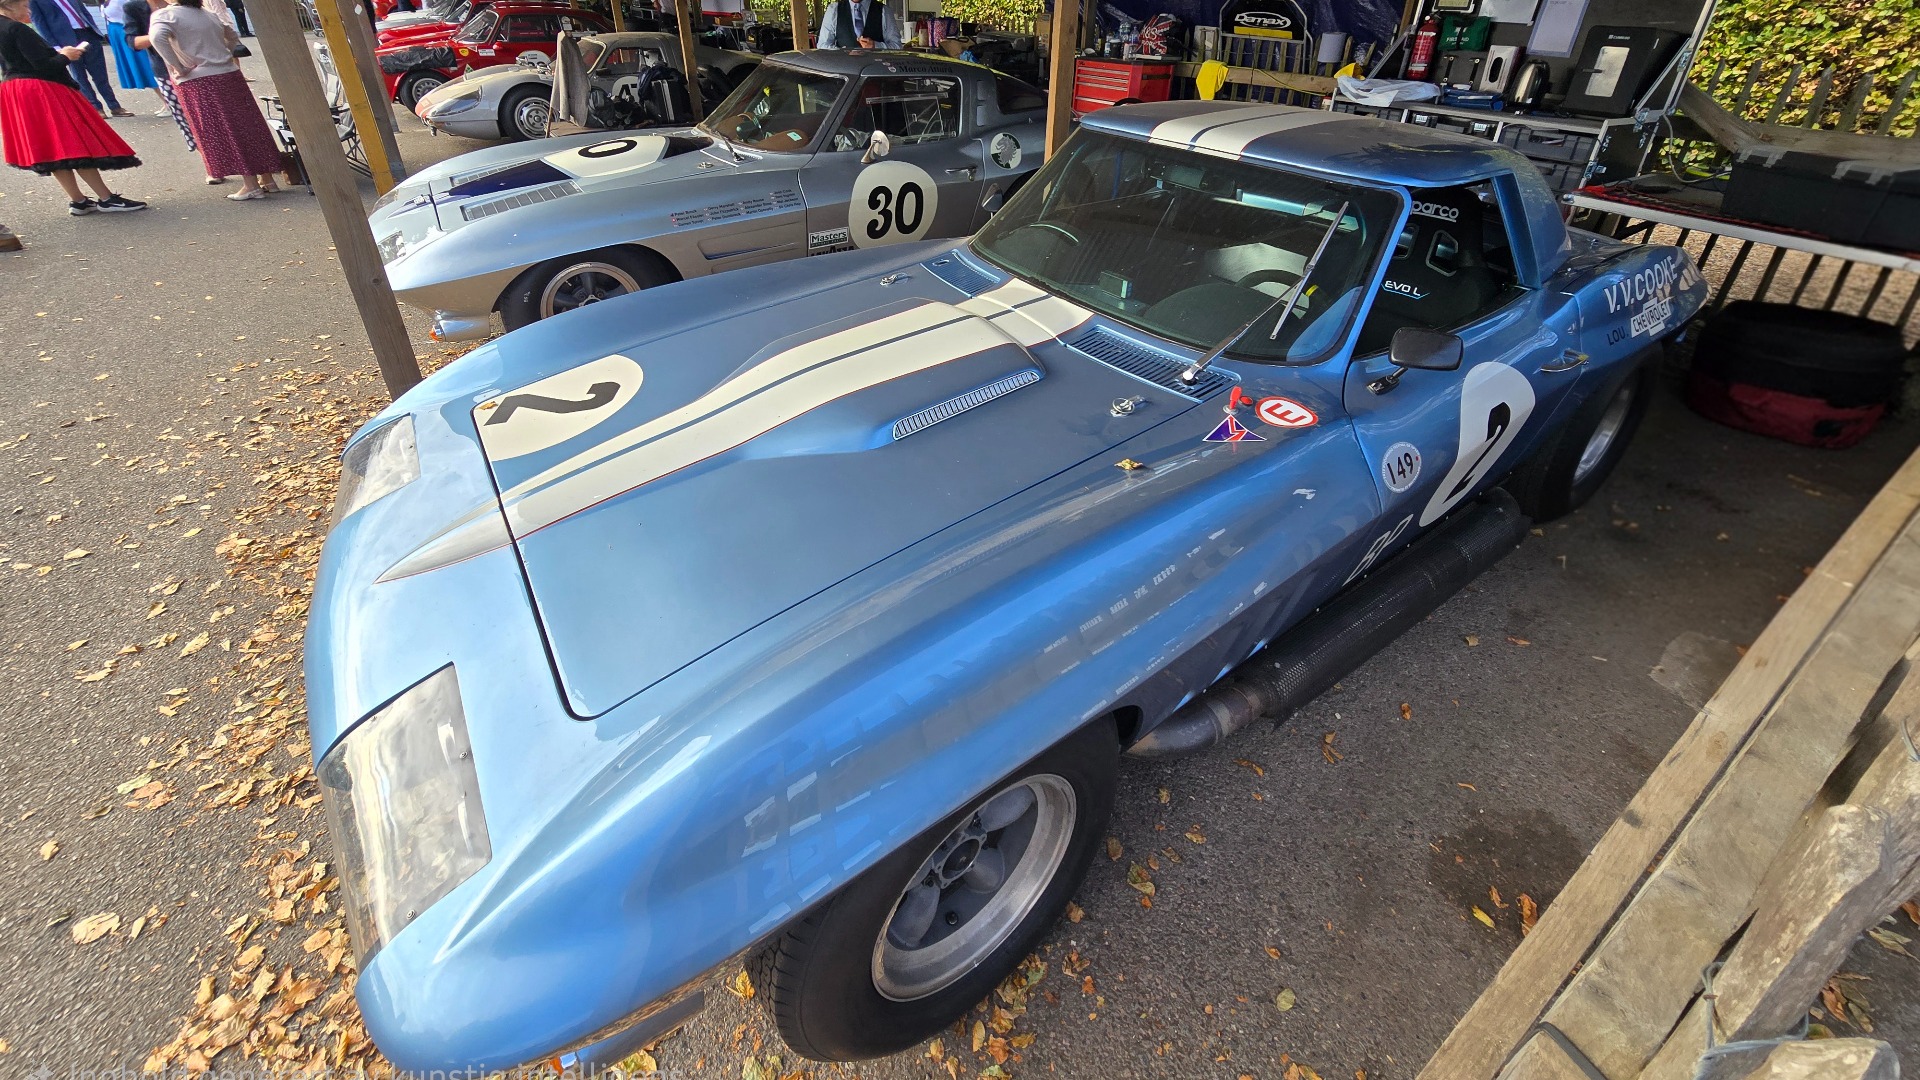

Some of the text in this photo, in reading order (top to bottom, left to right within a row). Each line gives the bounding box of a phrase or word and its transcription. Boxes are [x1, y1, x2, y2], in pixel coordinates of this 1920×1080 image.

[1234, 14, 1284, 26] Damax
[867, 182, 923, 239] 30
[1410, 200, 1459, 219] parco
[812, 232, 846, 242] Masters
[1385, 281, 1420, 296] EVO L
[1632, 300, 1672, 332] CHEVROLET
[484, 382, 621, 426] 2
[1264, 402, 1307, 424] E
[1443, 402, 1510, 504] 2
[1387, 452, 1413, 484] 149
